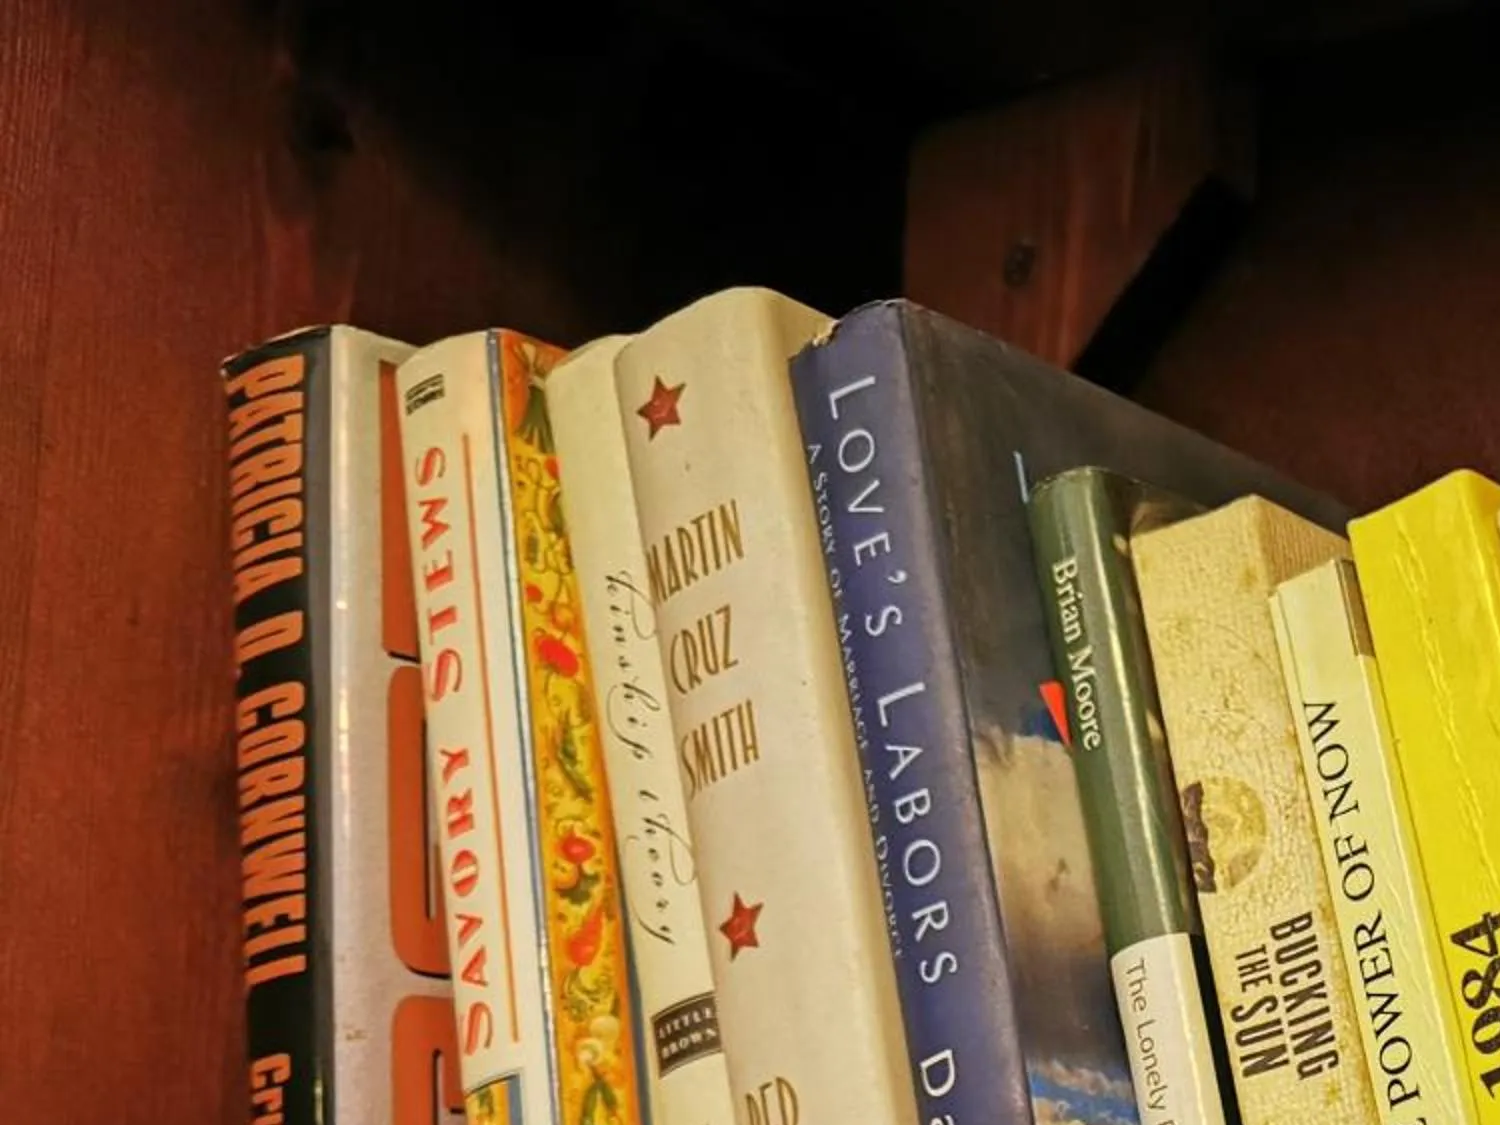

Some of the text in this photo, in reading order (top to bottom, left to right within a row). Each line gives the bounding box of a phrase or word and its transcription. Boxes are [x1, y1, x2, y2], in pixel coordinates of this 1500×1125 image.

[225, 353, 304, 604] PATRICIA
[416, 446, 462, 702] STEWS
[648, 498, 745, 604] MARTIN
[670, 603, 739, 695] CRUZ
[829, 375, 958, 984] LOVE'S LABORS
[1053, 557, 1101, 752] Brian Moore
[681, 697, 760, 800] SMITH
[1303, 701, 1360, 827] NOW
[237, 681, 307, 986] CORNWELL
[1333, 834, 1375, 902] OF
[440, 747, 495, 1056] SAVORY
[1126, 957, 1148, 1013] The
[1235, 944, 1273, 993] THE
[1270, 911, 1339, 1081] BUCKING
[1354, 908, 1422, 1112] POWER
[658, 1006, 715, 1039] LITTLE
[661, 1027, 718, 1059] BROWN
[1136, 1019, 1171, 1113] Lonely
[1231, 995, 1290, 1079] SUN
